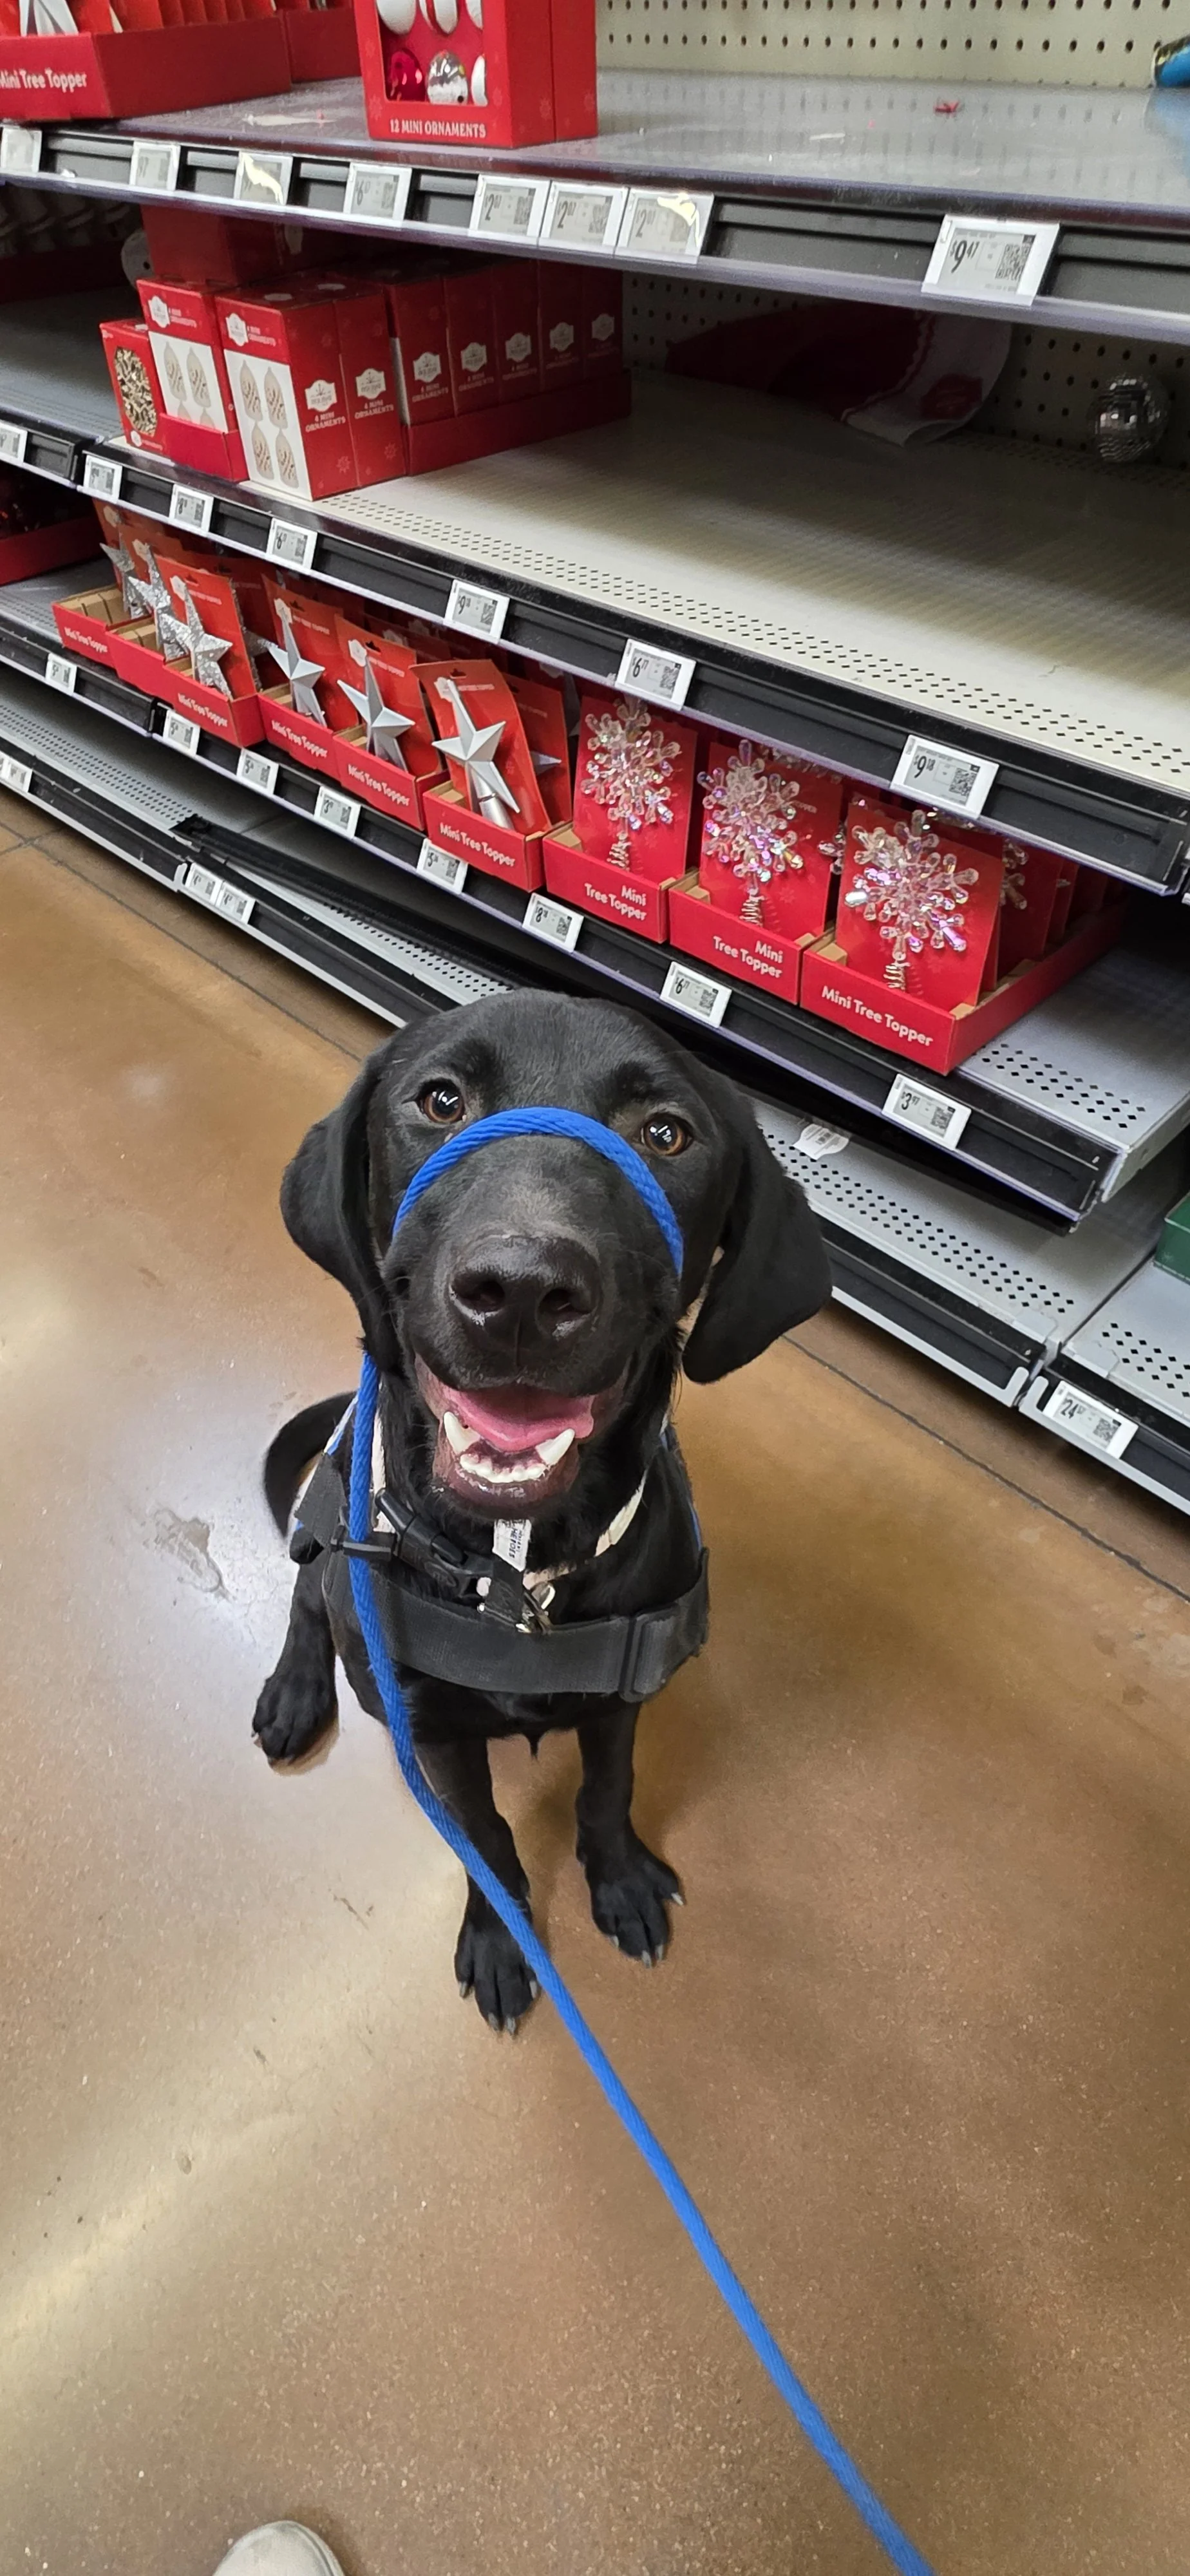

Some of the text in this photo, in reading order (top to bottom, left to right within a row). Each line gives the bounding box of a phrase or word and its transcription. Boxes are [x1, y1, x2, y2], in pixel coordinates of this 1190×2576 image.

[19, 68, 46, 89] Tree
[44, 68, 87, 93] Topper
[390, 118, 486, 138] 12 MINI ORNAMENTS
[440, 822, 515, 867] Mini Tree Topper
[584, 882, 647, 921] Tree Topper
[621, 885, 647, 906] Mini
[713, 936, 782, 978] Tree Topper
[755, 940, 783, 963] Mini
[822, 985, 933, 1046] Mini Tree Topper
